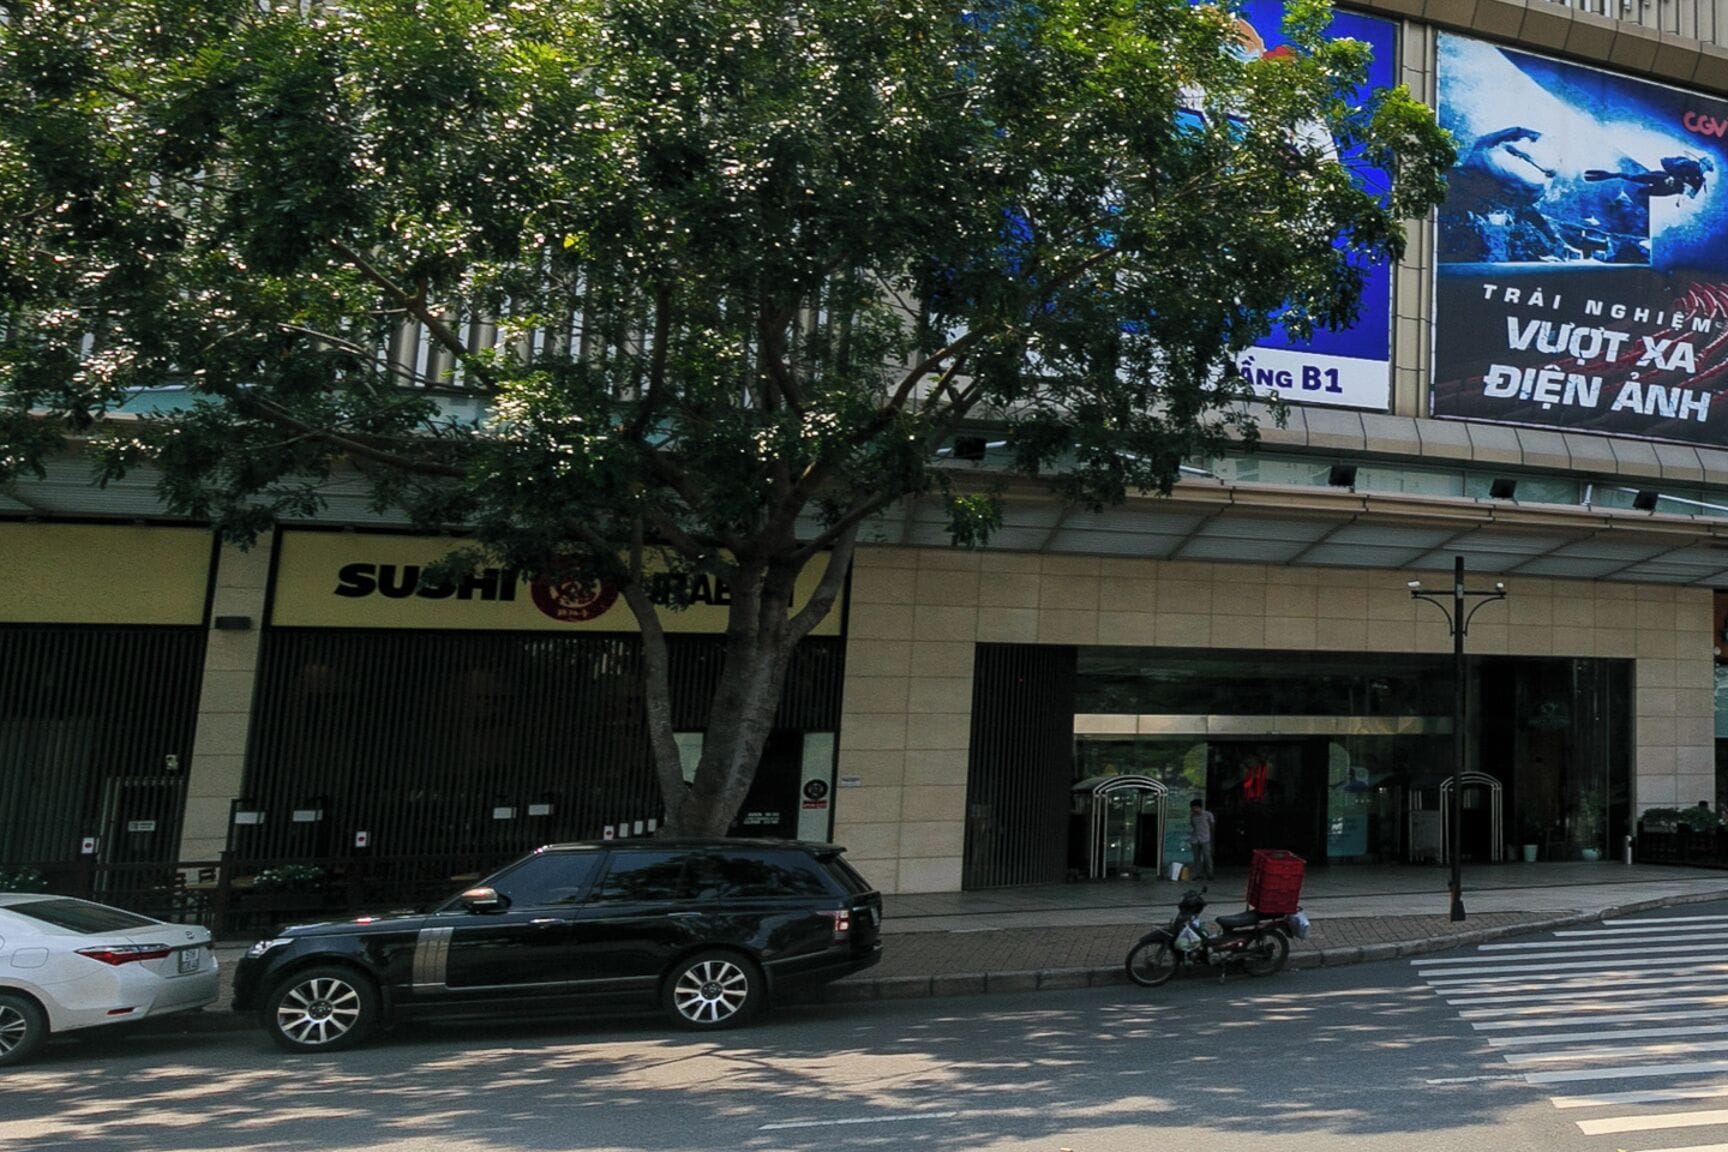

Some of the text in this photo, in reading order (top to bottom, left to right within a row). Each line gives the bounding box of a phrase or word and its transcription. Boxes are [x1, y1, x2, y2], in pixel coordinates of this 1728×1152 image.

[1683, 111, 1728, 138] CGV
[1482, 283, 1712, 334] TRẢI NGHIỆM
[1506, 315, 1697, 374] VƯỢT XA
[1230, 355, 1343, 394] ẦNG B1
[1483, 364, 1712, 422] ĐIỆN ẢNH
